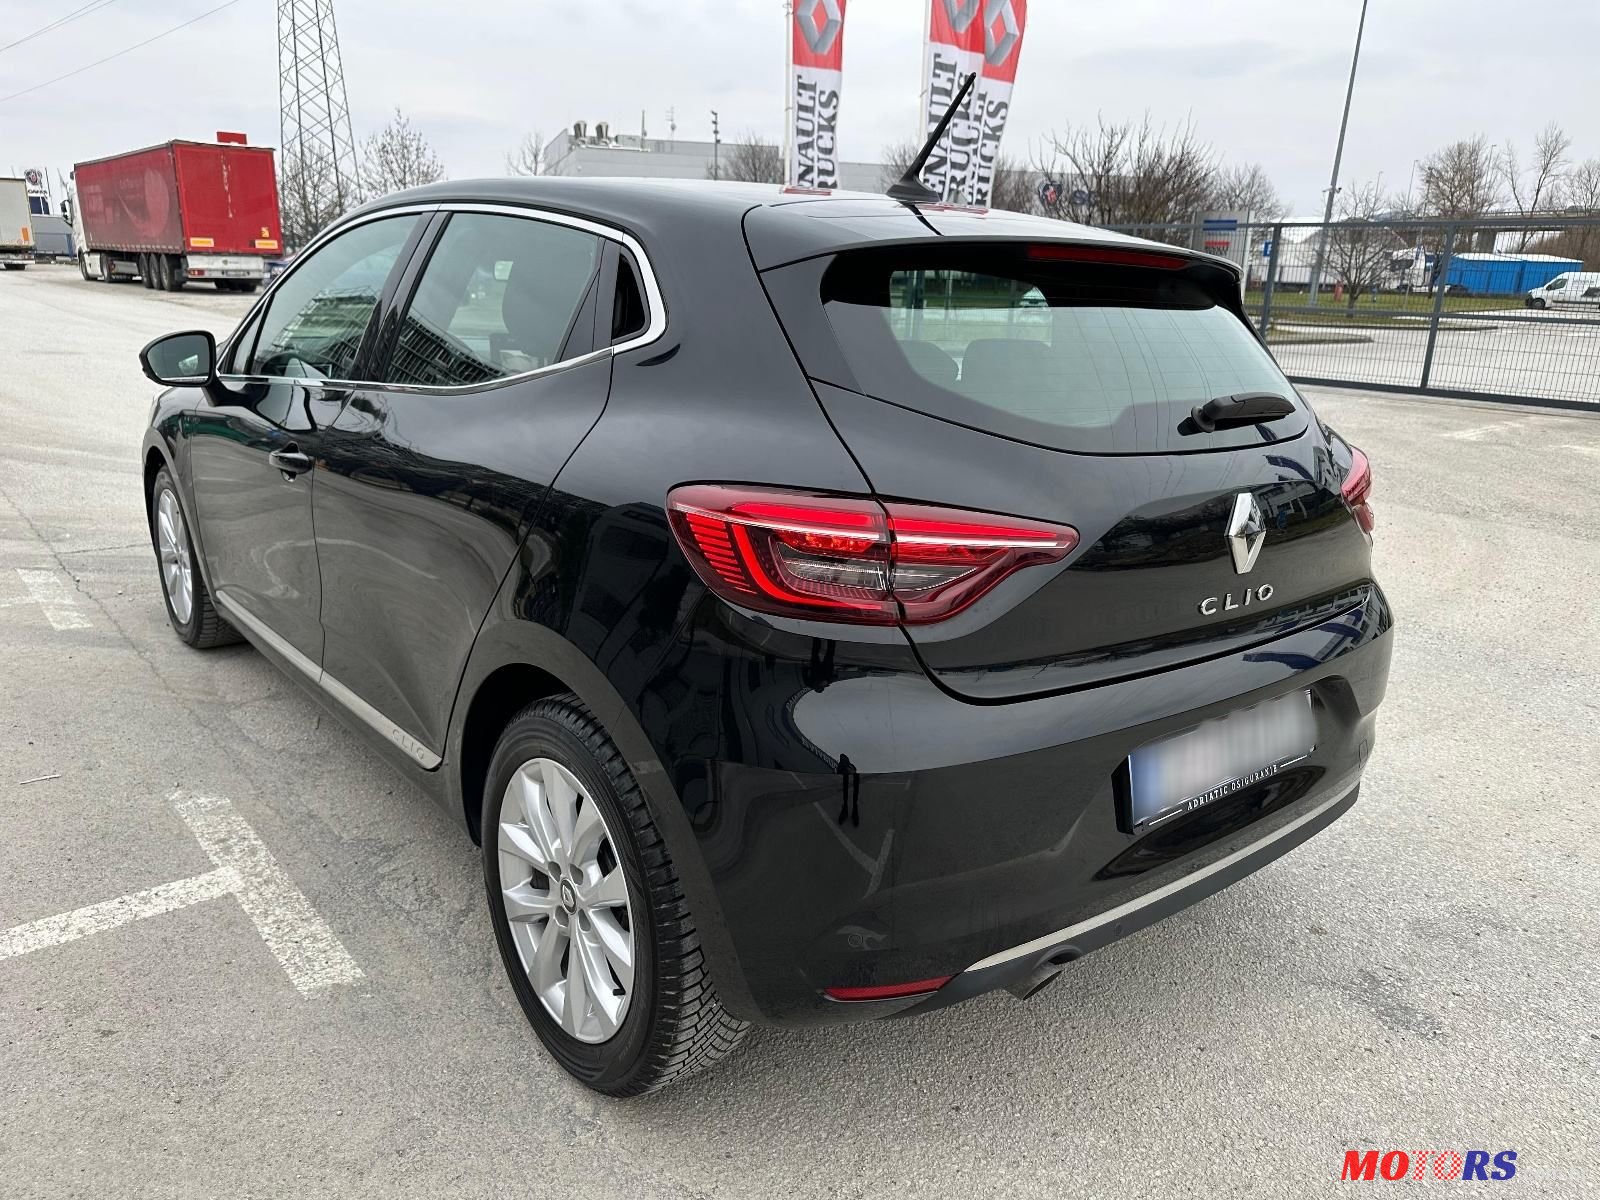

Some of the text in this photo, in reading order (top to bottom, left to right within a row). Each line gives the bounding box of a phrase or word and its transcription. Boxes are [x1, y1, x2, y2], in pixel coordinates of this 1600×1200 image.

[796, 74, 817, 187] NAULT
[1200, 583, 1274, 615] CLIO
[392, 729, 424, 760] CLIO
[1187, 788, 1228, 811] ADRIATIC
